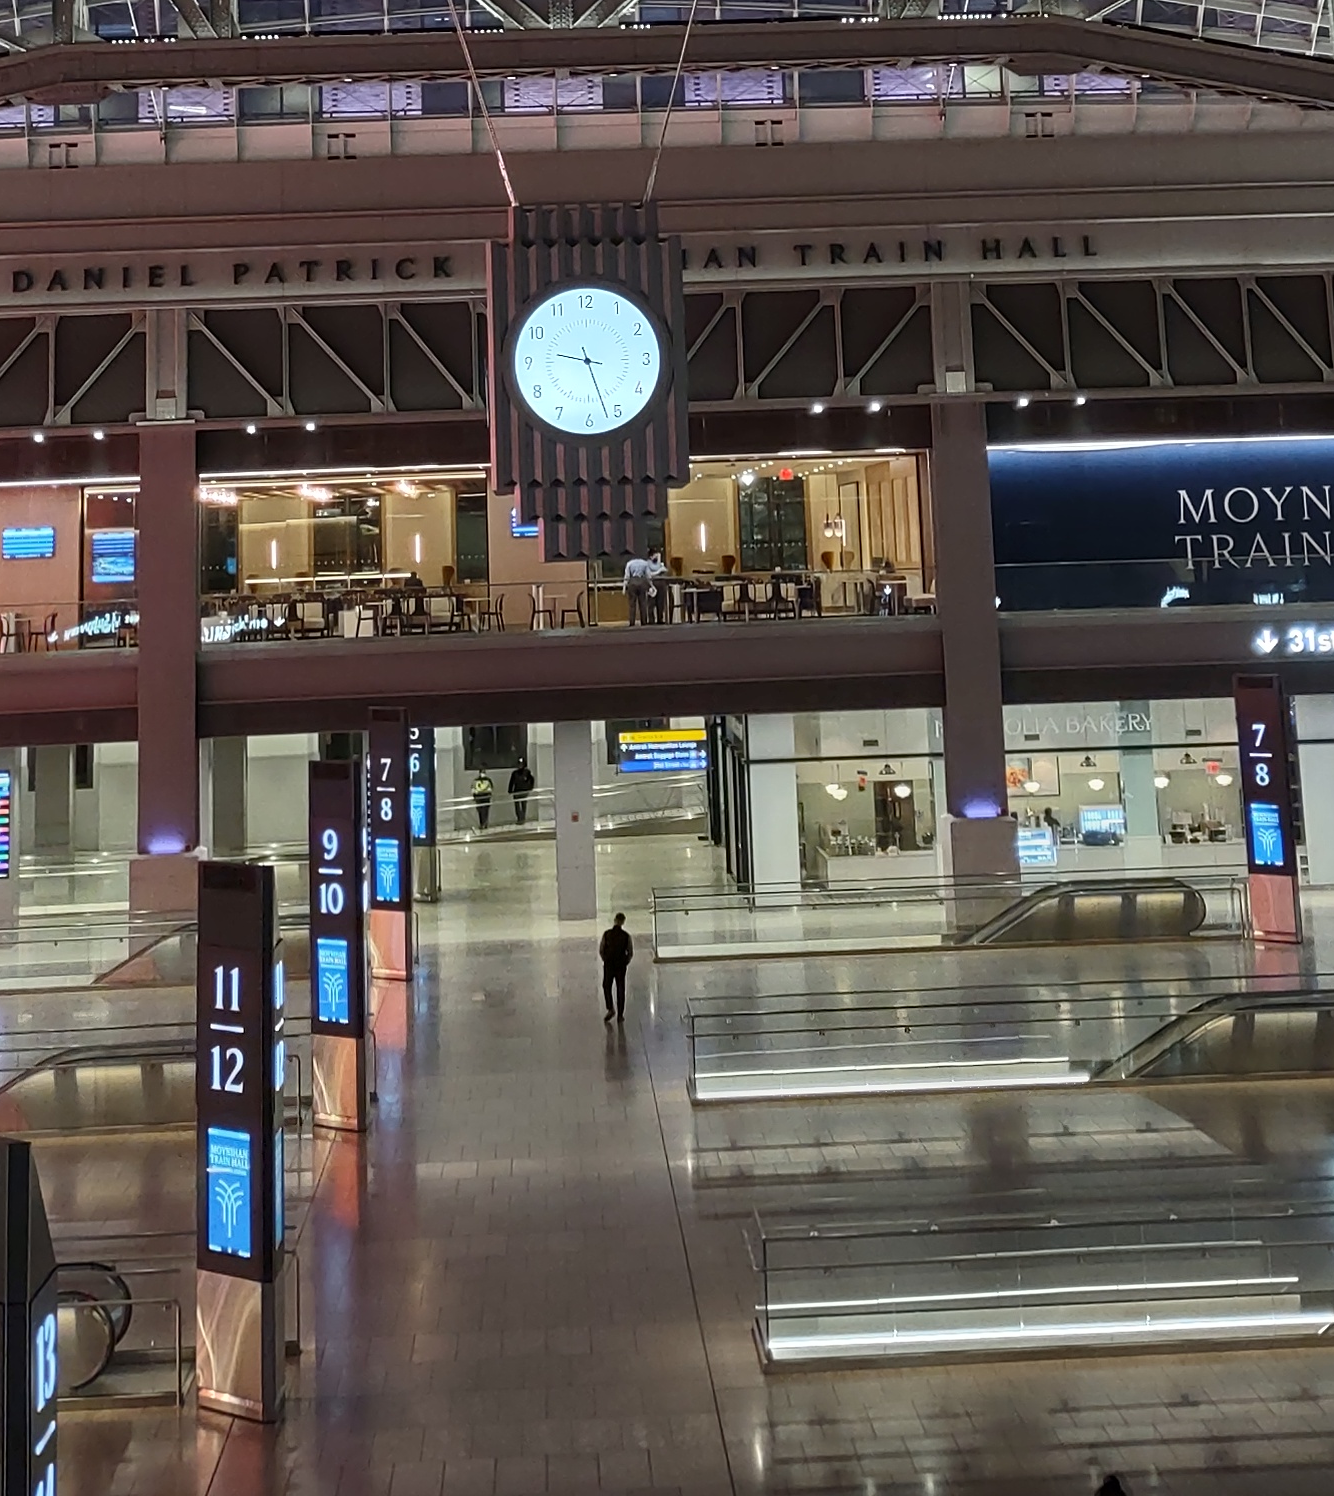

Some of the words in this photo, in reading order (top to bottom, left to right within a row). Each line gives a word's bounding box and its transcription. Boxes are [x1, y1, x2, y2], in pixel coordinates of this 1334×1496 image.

[11, 264, 195, 293] DANIEL
[233, 257, 455, 285] PATRICK
[792, 240, 946, 266] TRAIN
[980, 235, 1099, 260] HALL
[550, 303, 563, 316] 11
[578, 295, 593, 309] 12
[613, 301, 619, 315] 1
[528, 326, 544, 340] 10
[633, 322, 642, 336] 2
[524, 356, 533, 370] 9
[642, 352, 651, 365] 3
[533, 384, 542, 398] 8
[634, 380, 643, 395] 4
[555, 406, 564, 420] 7
[585, 413, 594, 427] 6
[613, 404, 622, 418] 5
[1174, 530, 1333, 570] TRAIN
[1066, 712, 1154, 736] BAKERY
[1251, 723, 1266, 747] 7
[380, 758, 392, 782] 7
[1255, 763, 1270, 786] 8
[380, 797, 393, 821] 8
[322, 829, 338, 860] 9
[319, 883, 344, 915] 10
[214, 965, 241, 1011] 11
[210, 1045, 244, 1094] 12
[36, 1313, 56, 1413] 13
